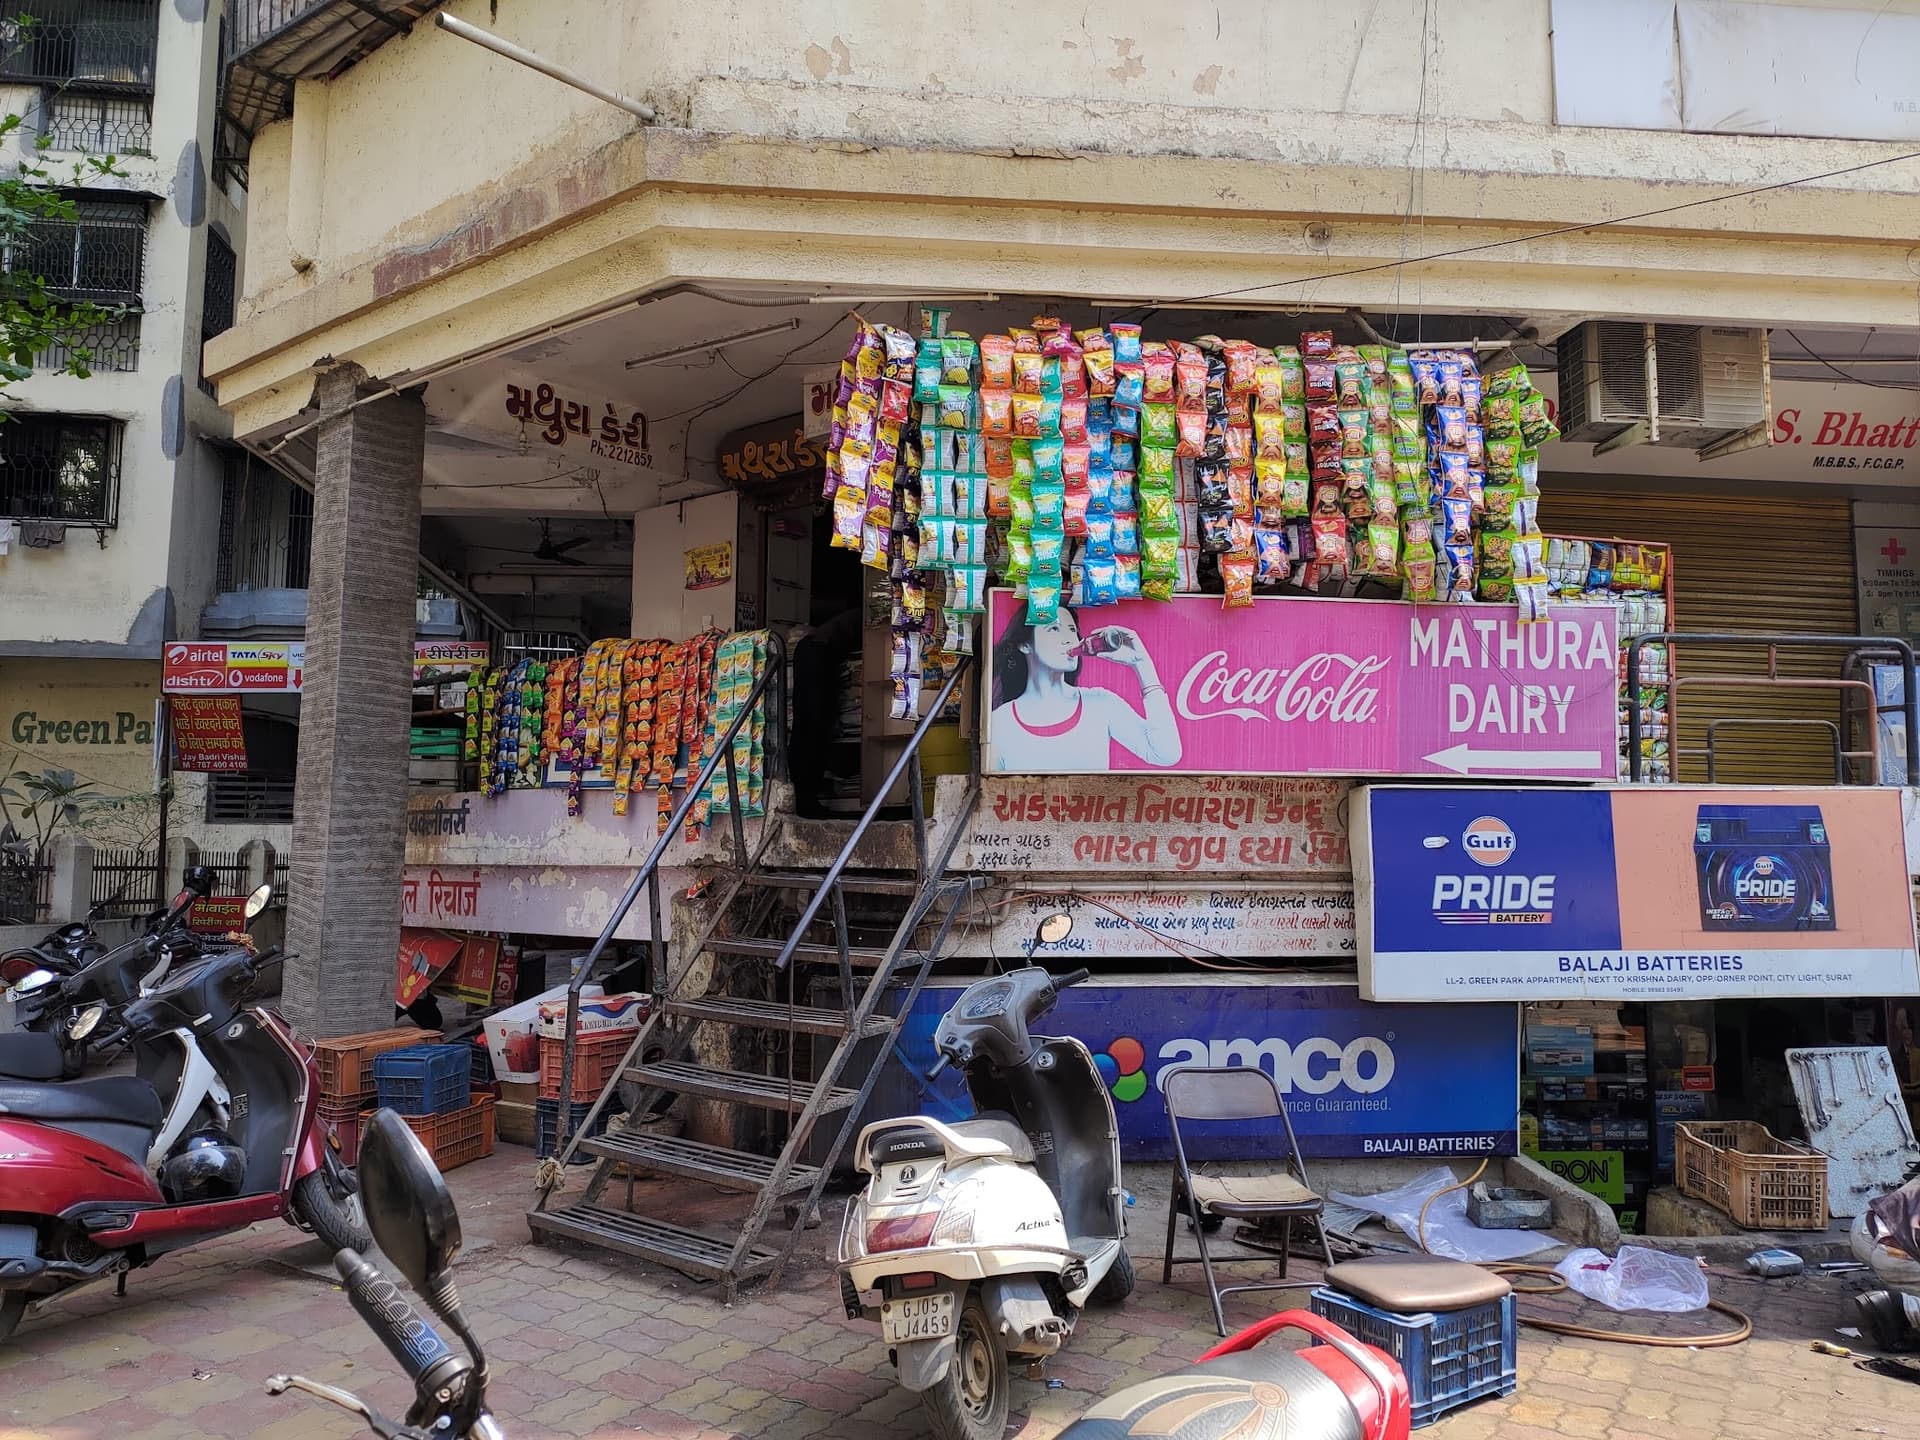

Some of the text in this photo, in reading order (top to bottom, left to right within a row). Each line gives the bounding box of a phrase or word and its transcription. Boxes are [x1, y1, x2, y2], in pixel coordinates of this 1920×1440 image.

[506, 384, 650, 450] મથુરા ડેરી
[1773, 409, 1801, 444] S.
[1410, 618, 1613, 671] MATHURA
[190, 649, 224, 662] airtel
[231, 651, 257, 659] TATA
[244, 673, 284, 683] vodafone
[1176, 650, 1392, 724] Coca-Cola
[216, 698, 239, 711] मकान
[1449, 684, 1577, 735] DAIRY
[12, 711, 112, 746] Green
[182, 753, 197, 762] Jay
[199, 753, 220, 761] Badri
[1466, 834, 1512, 849] Gulf
[1073, 835, 1157, 863] ભારત
[1167, 835, 1227, 870] જીવ
[428, 869, 481, 920] रिचार्ज
[1432, 875, 1556, 910] PRIDE
[1735, 879, 1796, 898] PRIDE
[1496, 914, 1545, 923] BATTERY
[1558, 955, 1743, 972] BALAJI BATTERIES
[1468, 976, 1498, 985] GREEN
[1501, 976, 1524, 985] PARK
[1587, 975, 1610, 984] NEXT
[1612, 975, 1625, 984] TO
[1627, 974, 1664, 984] KRISHNA
[1666, 974, 1694, 984] DAIRY,
[1715, 974, 1746, 983] ORNER
[1777, 973, 1797, 982] CITY
[1826, 973, 1853, 982] SURAT
[1156, 1037, 1395, 1095] amco
[1315, 1096, 1392, 1113] Guaranteed.
[889, 1141, 927, 1152] HONDA
[1363, 1135, 1496, 1155] BALAJI BATTERIES
[1539, 1159, 1609, 1184] RON
[1015, 1219, 1050, 1233] Activa
[903, 1296, 939, 1318] GJ05
[893, 1315, 949, 1341] LJ4459
